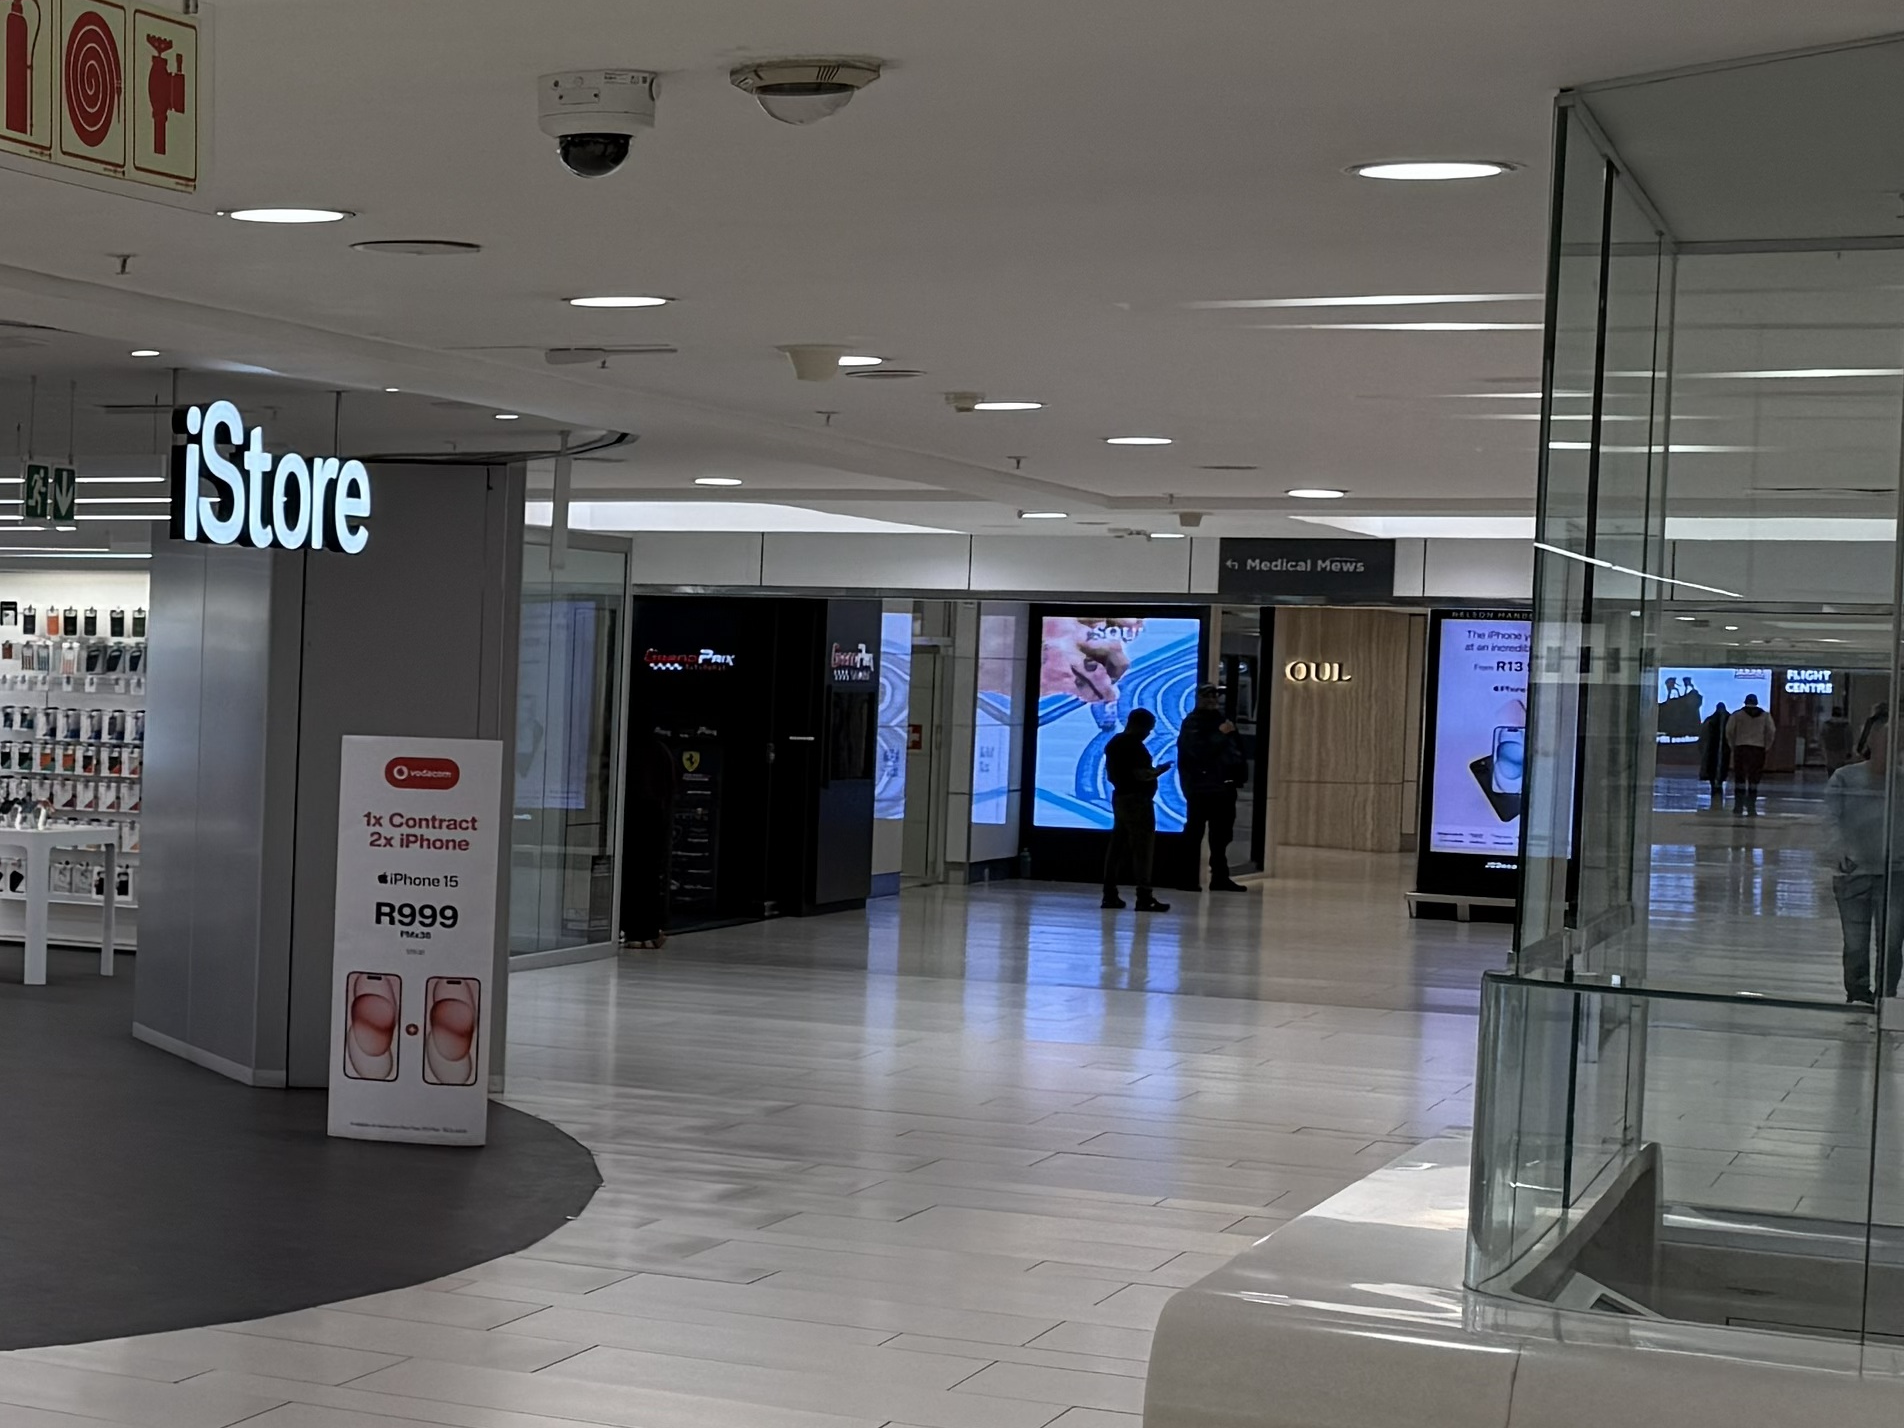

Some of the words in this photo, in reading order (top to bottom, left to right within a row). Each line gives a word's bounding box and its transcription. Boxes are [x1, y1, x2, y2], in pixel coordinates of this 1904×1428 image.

[184, 399, 371, 555] iStore
[1246, 558, 1311, 572] Medical
[1316, 557, 1365, 573] Mews
[1467, 630, 1486, 640] The
[1496, 660, 1524, 673] R13
[1786, 669, 1832, 682] FLIGHT
[363, 811, 383, 828] 1x
[388, 812, 478, 831] Contract
[369, 831, 394, 848] 2x
[399, 833, 470, 851] iPhone
[390, 872, 441, 887] iPhone
[443, 875, 459, 888] 15
[375, 901, 459, 929] R999
